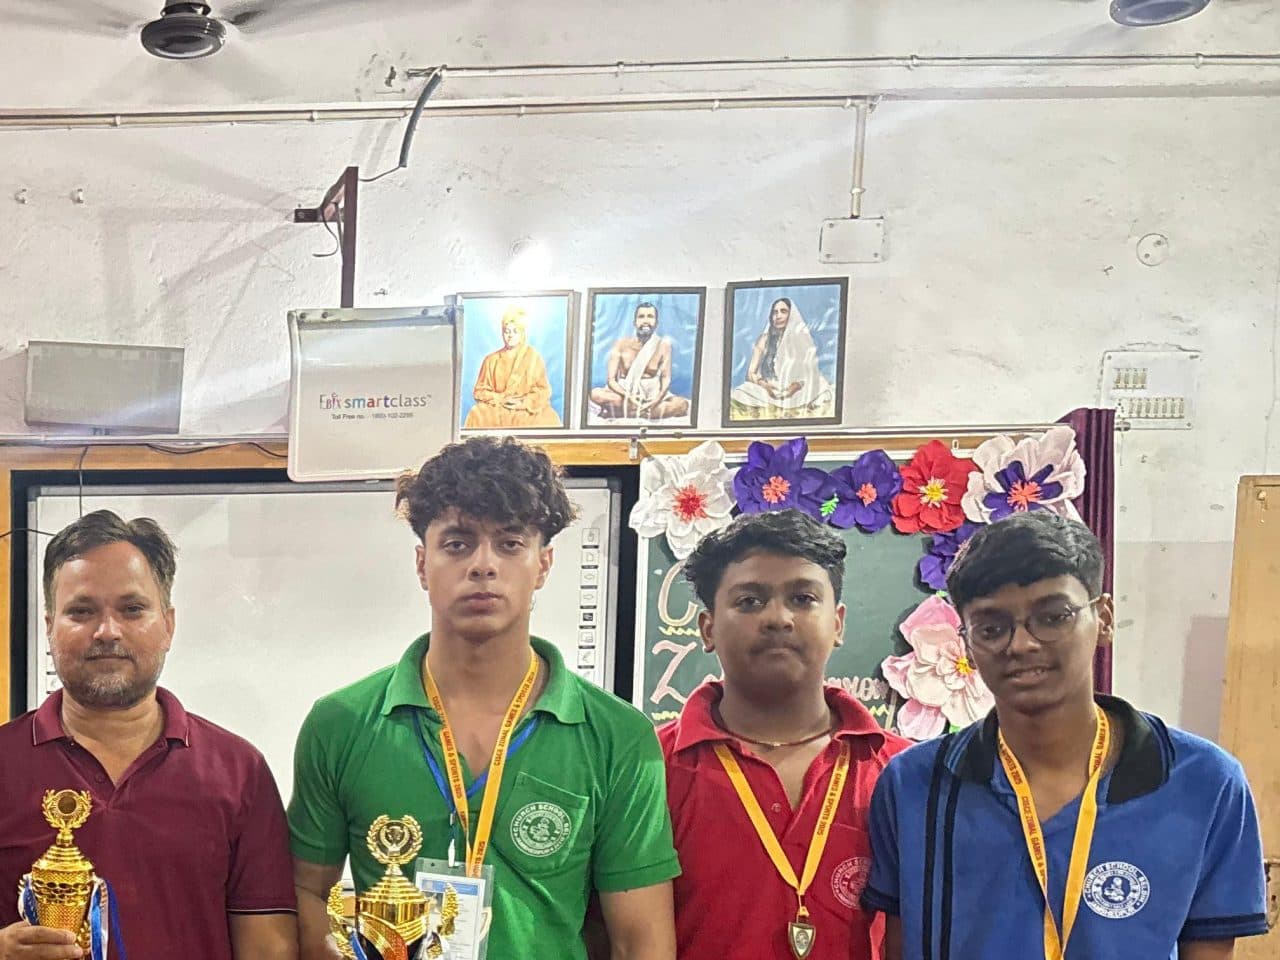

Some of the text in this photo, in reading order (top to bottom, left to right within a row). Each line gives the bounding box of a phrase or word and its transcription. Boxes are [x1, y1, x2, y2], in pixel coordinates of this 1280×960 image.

[504, 708, 517, 728] GAMES
[442, 731, 453, 751] GAMES
[448, 758, 460, 782] SPORTS
[454, 783, 463, 798] 2025
[512, 804, 537, 833] CHURCH
[476, 839, 485, 856] 2025
[1030, 837, 1043, 860] GAMES
[1084, 865, 1105, 894] CHURCH
